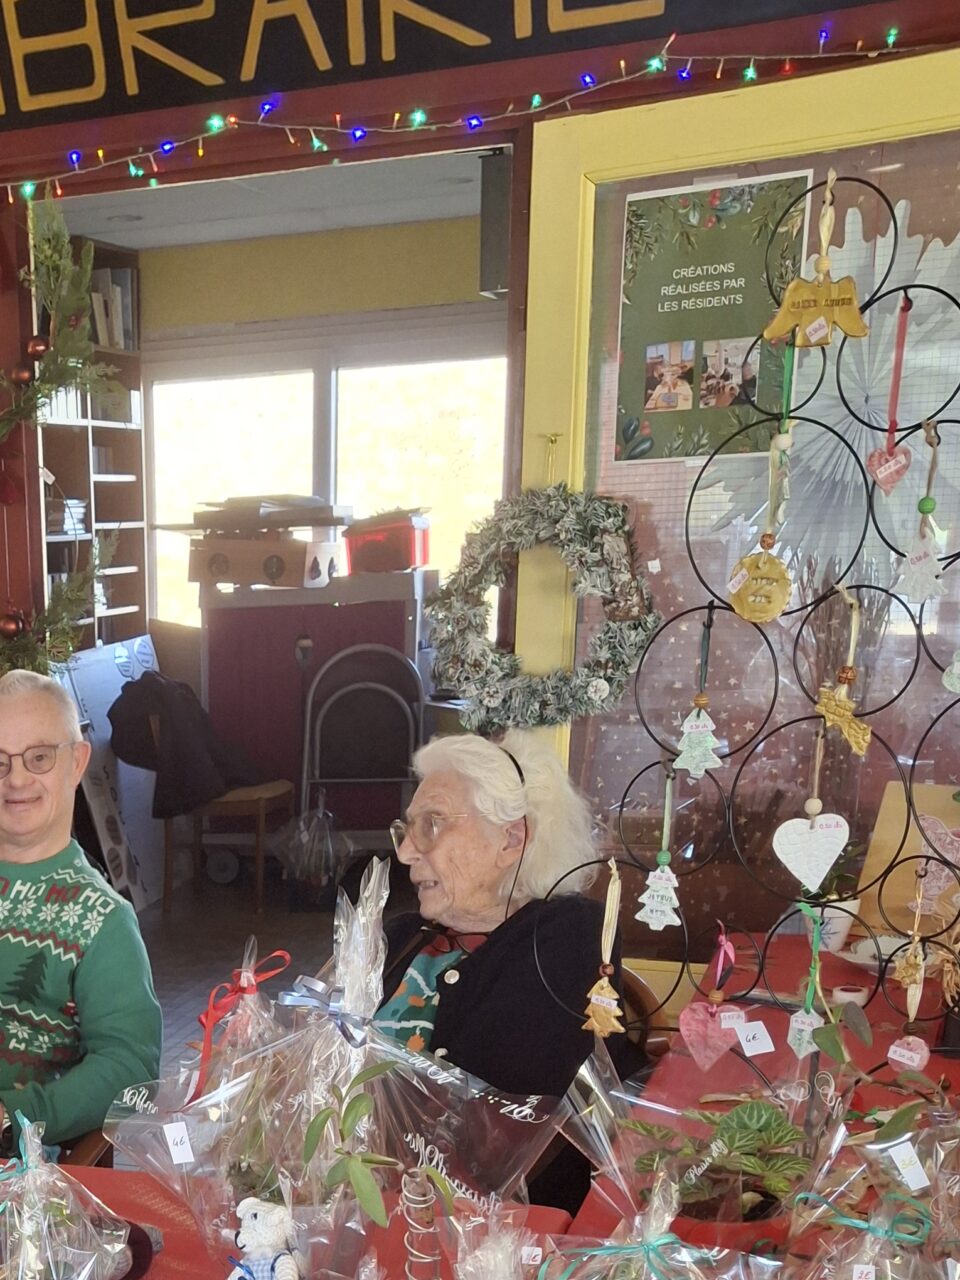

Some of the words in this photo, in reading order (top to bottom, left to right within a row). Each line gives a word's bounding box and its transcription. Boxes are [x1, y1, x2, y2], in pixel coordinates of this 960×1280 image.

[672, 262, 735, 279] CRÉATIONS
[661, 280, 720, 296] RÉALISÉES
[723, 278, 746, 289] PAR
[657, 301, 679, 312] LES
[681, 294, 743, 310] RÉSIDENTS
[10, 879, 46, 900] HO
[79, 887, 116, 914] HO
